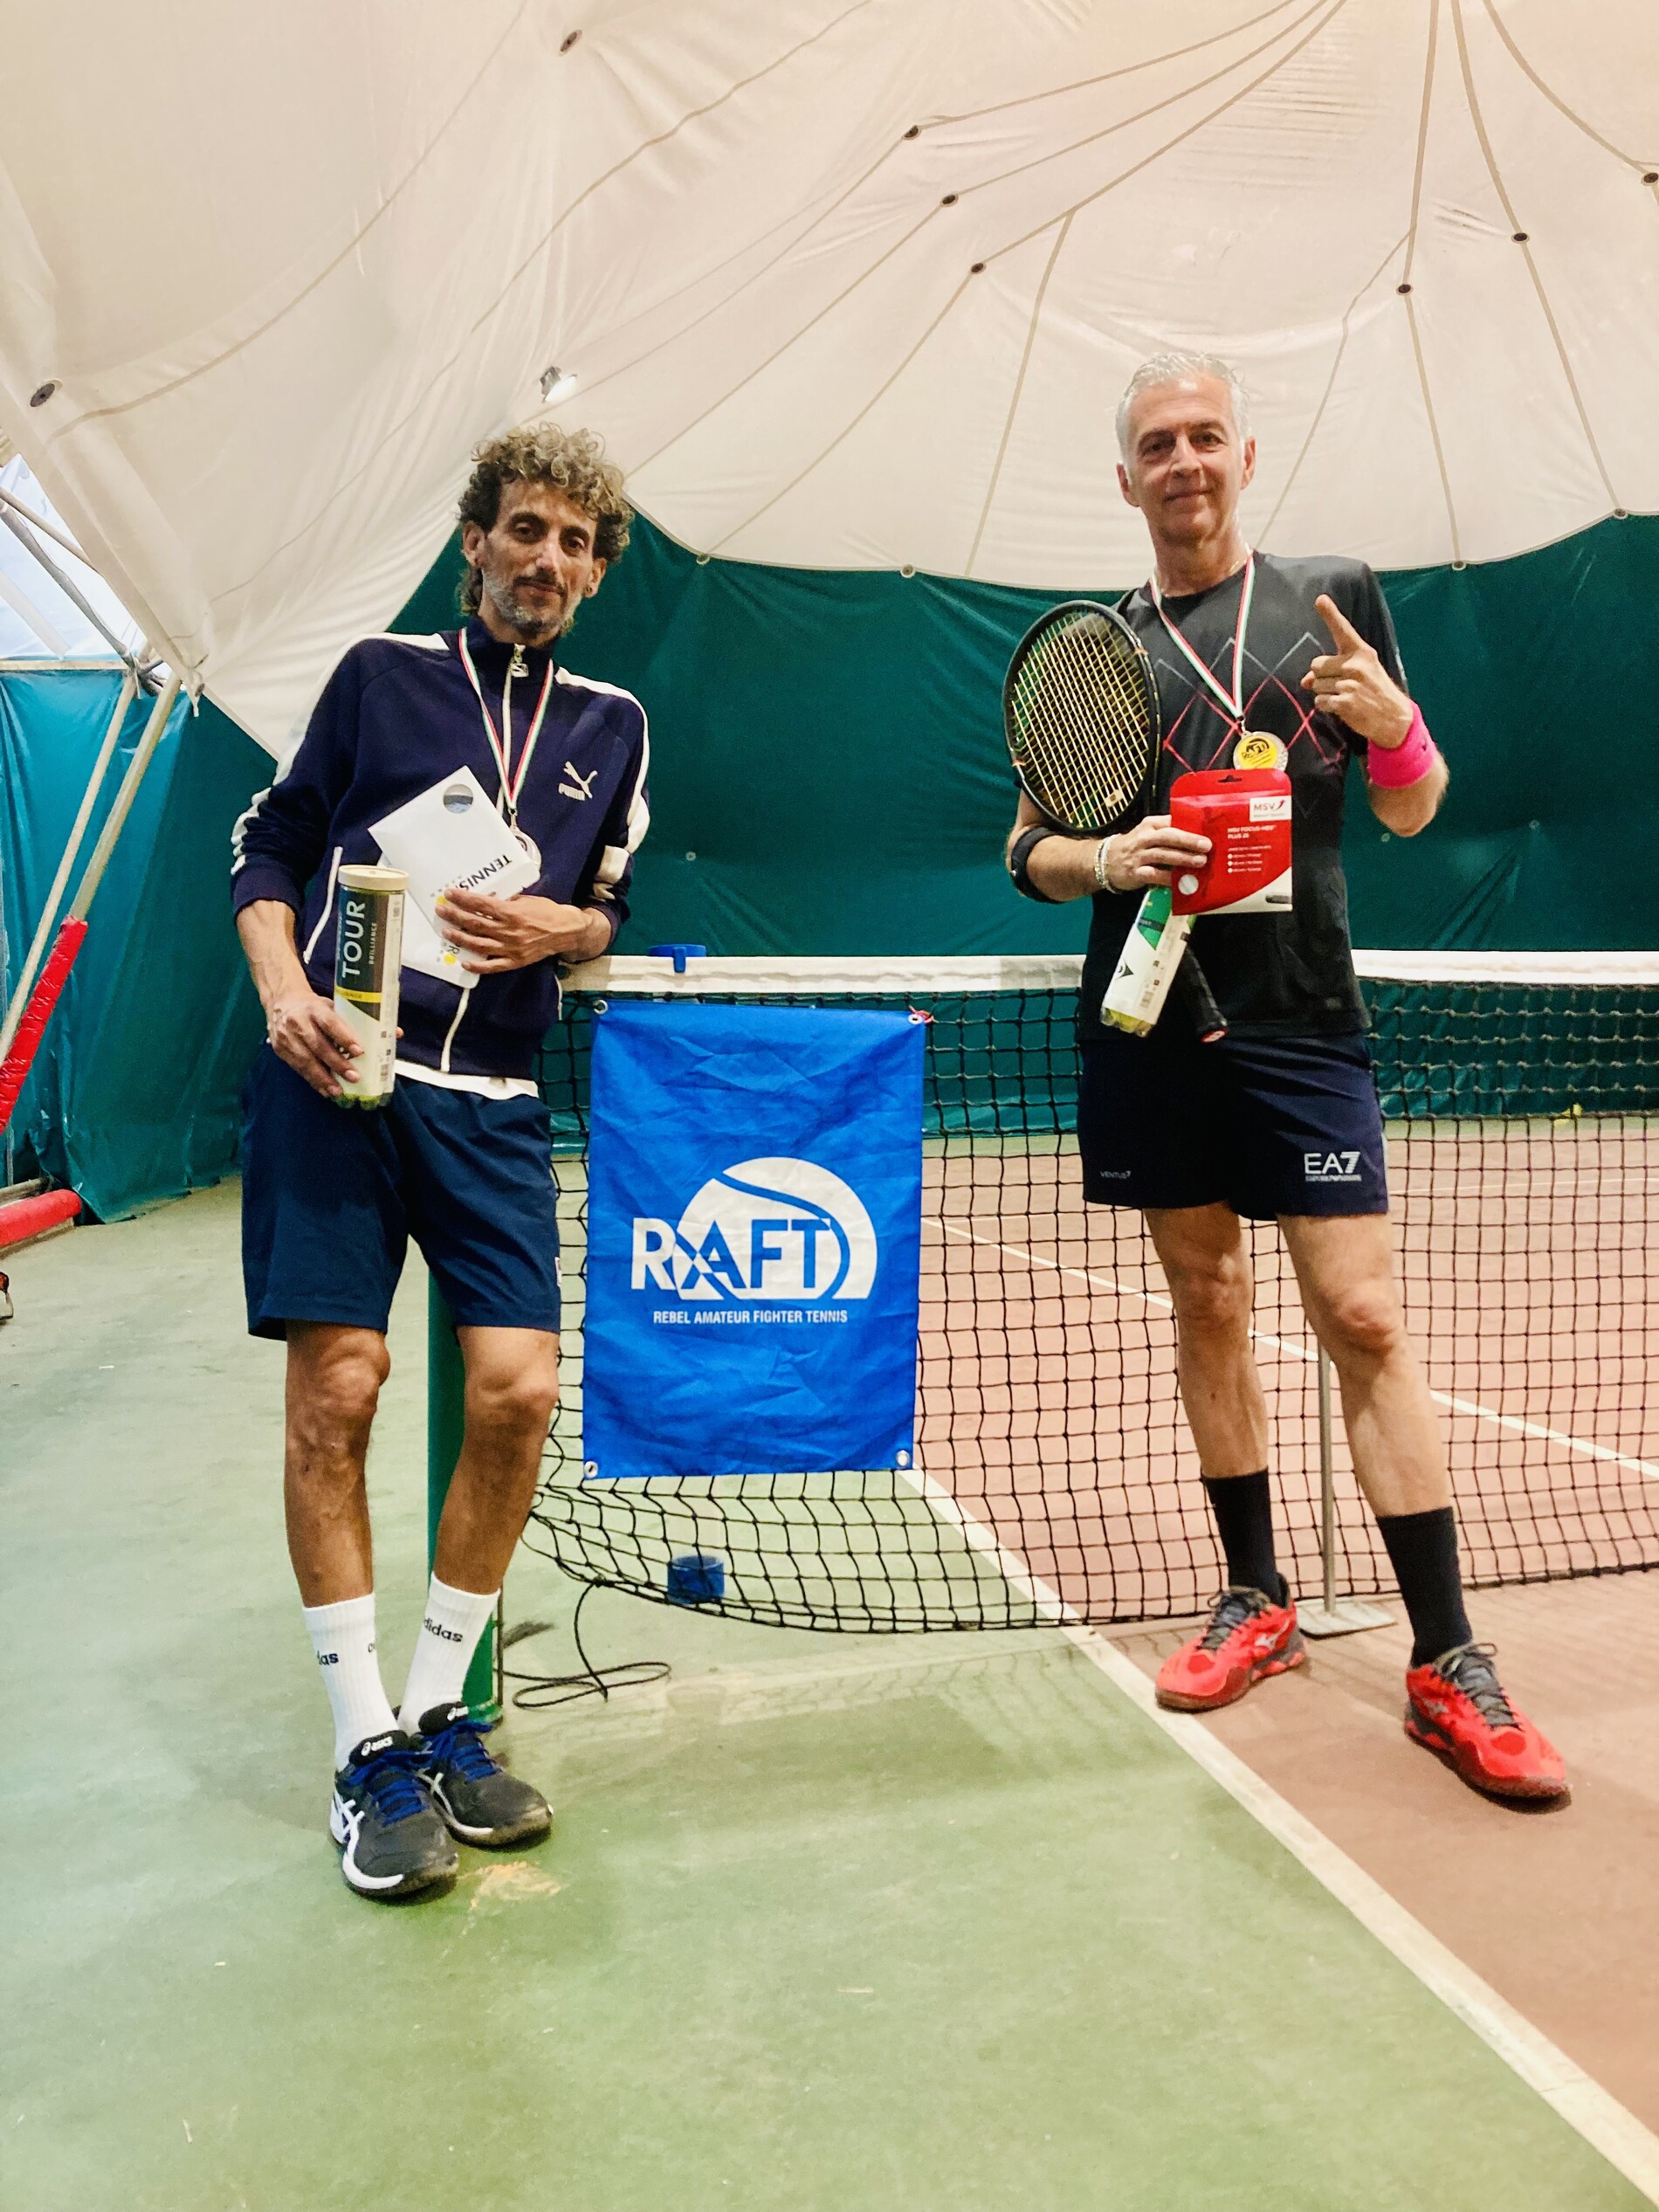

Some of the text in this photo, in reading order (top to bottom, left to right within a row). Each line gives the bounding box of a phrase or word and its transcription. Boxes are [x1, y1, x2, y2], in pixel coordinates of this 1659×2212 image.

[1253, 803, 1275, 811] MSV
[455, 853, 513, 892] TENNIS
[341, 900, 366, 978] TOUR
[1304, 1151, 1361, 1174] EA7
[653, 1309, 848, 1324] REBEL AMATEUR FIGHTER TENNIS
[423, 1617, 464, 1643] didas
